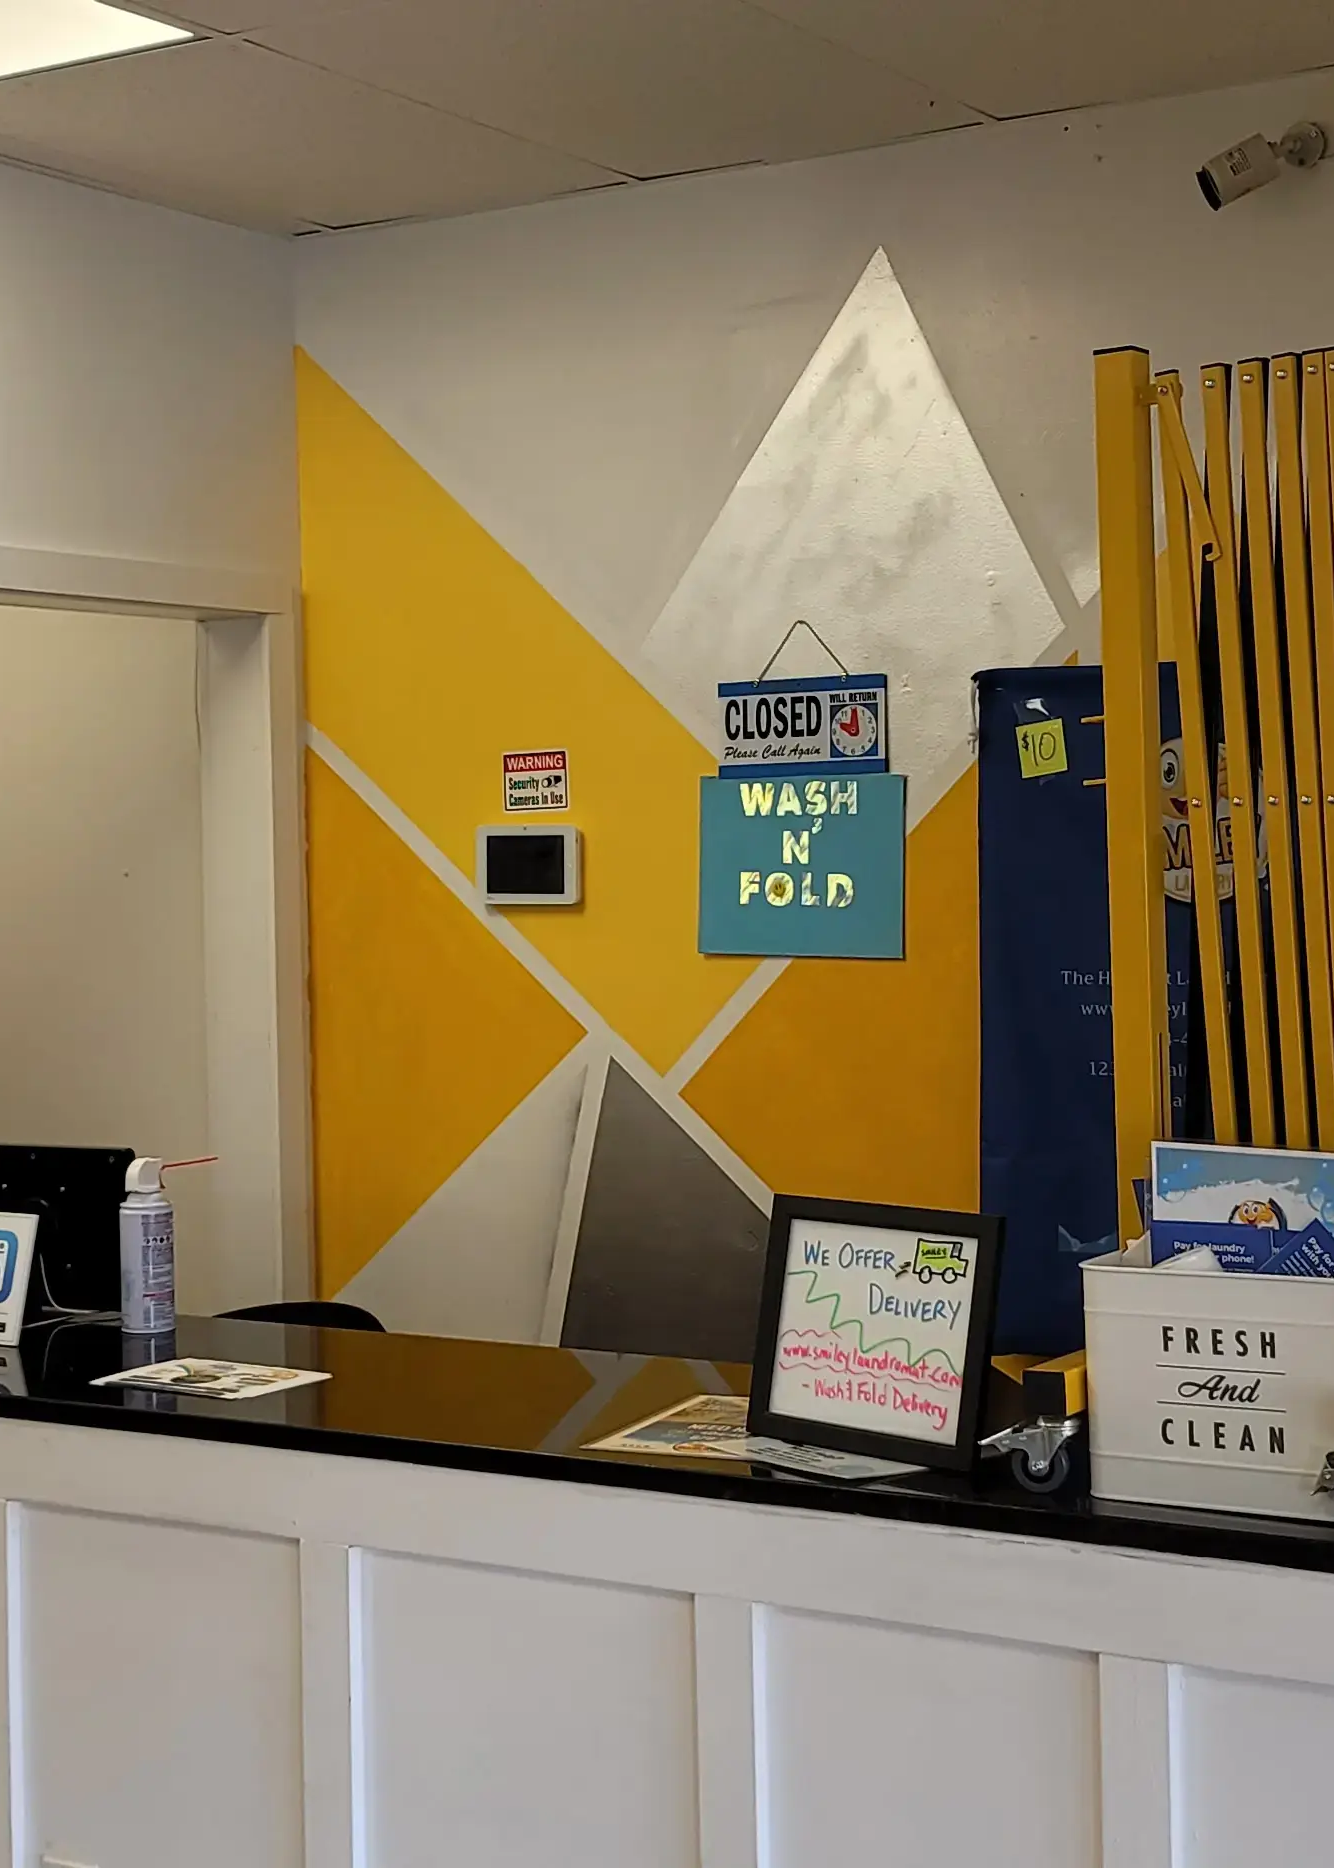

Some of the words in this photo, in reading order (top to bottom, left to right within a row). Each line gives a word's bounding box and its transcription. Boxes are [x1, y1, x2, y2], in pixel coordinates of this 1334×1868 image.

[829, 693, 847, 704] WILL
[848, 691, 878, 703] RETURN
[724, 695, 822, 741] CLOSED
[506, 754, 564, 771] WARNING
[724, 746, 758, 760] Please
[762, 745, 786, 761] Call
[788, 744, 821, 758] Again
[508, 776, 540, 792] Security
[508, 793, 540, 807] Cameras
[541, 792, 549, 804] In
[550, 791, 564, 805] Use
[739, 780, 858, 817] WASH
[738, 871, 855, 908] FOLD
[1061, 970, 1094, 985] The
[1173, 1241, 1191, 1251] Pay
[1301, 1243, 1319, 1265] with
[1307, 1236, 1324, 1254] Pay
[838, 1243, 897, 1272] OFFER
[1221, 1253, 1255, 1264] phone!
[869, 1283, 962, 1330] DELIVERY
[1161, 1325, 1277, 1359] FRESH
[1177, 1374, 1262, 1404] And
[814, 1378, 844, 1400] Wash
[857, 1382, 887, 1406] Fold
[892, 1386, 948, 1430] Delivery
[1160, 1417, 1286, 1455] CLEAN
